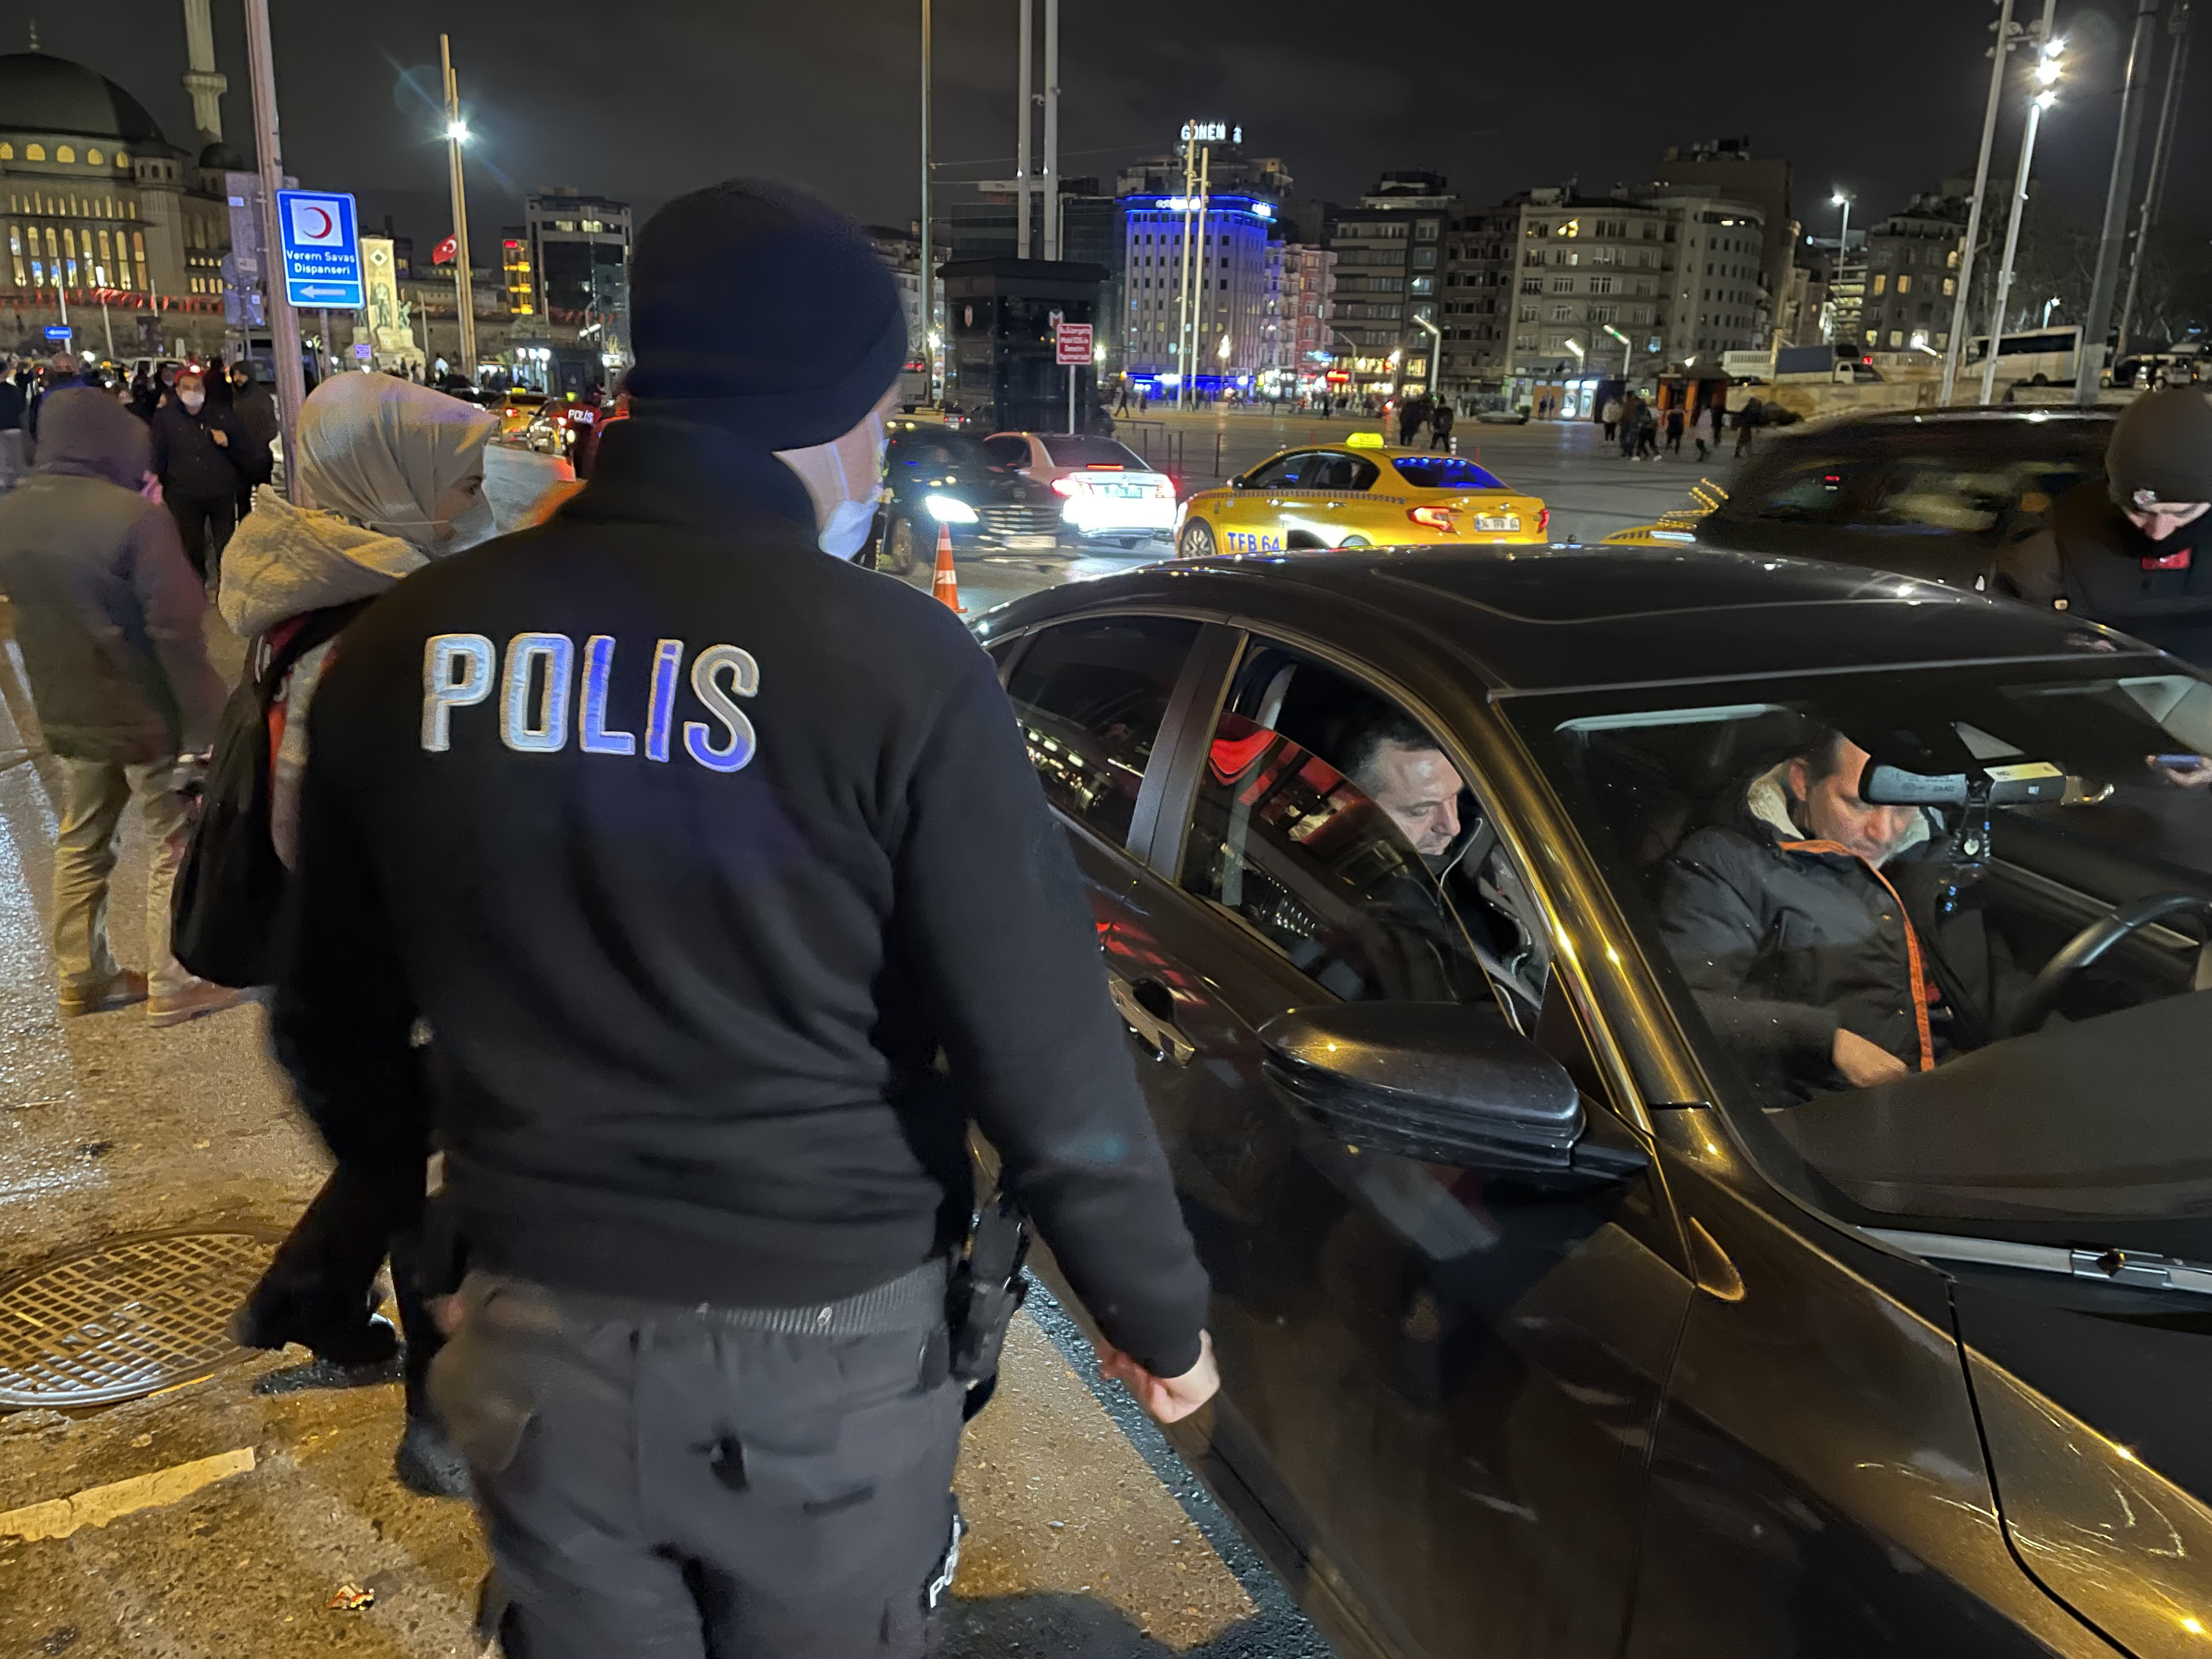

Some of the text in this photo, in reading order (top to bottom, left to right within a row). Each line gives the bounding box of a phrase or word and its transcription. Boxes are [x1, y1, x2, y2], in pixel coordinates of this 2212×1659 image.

[286, 250, 322, 261] Verem
[294, 262, 350, 275] Dispanseri
[1227, 532, 1257, 552] TFB
